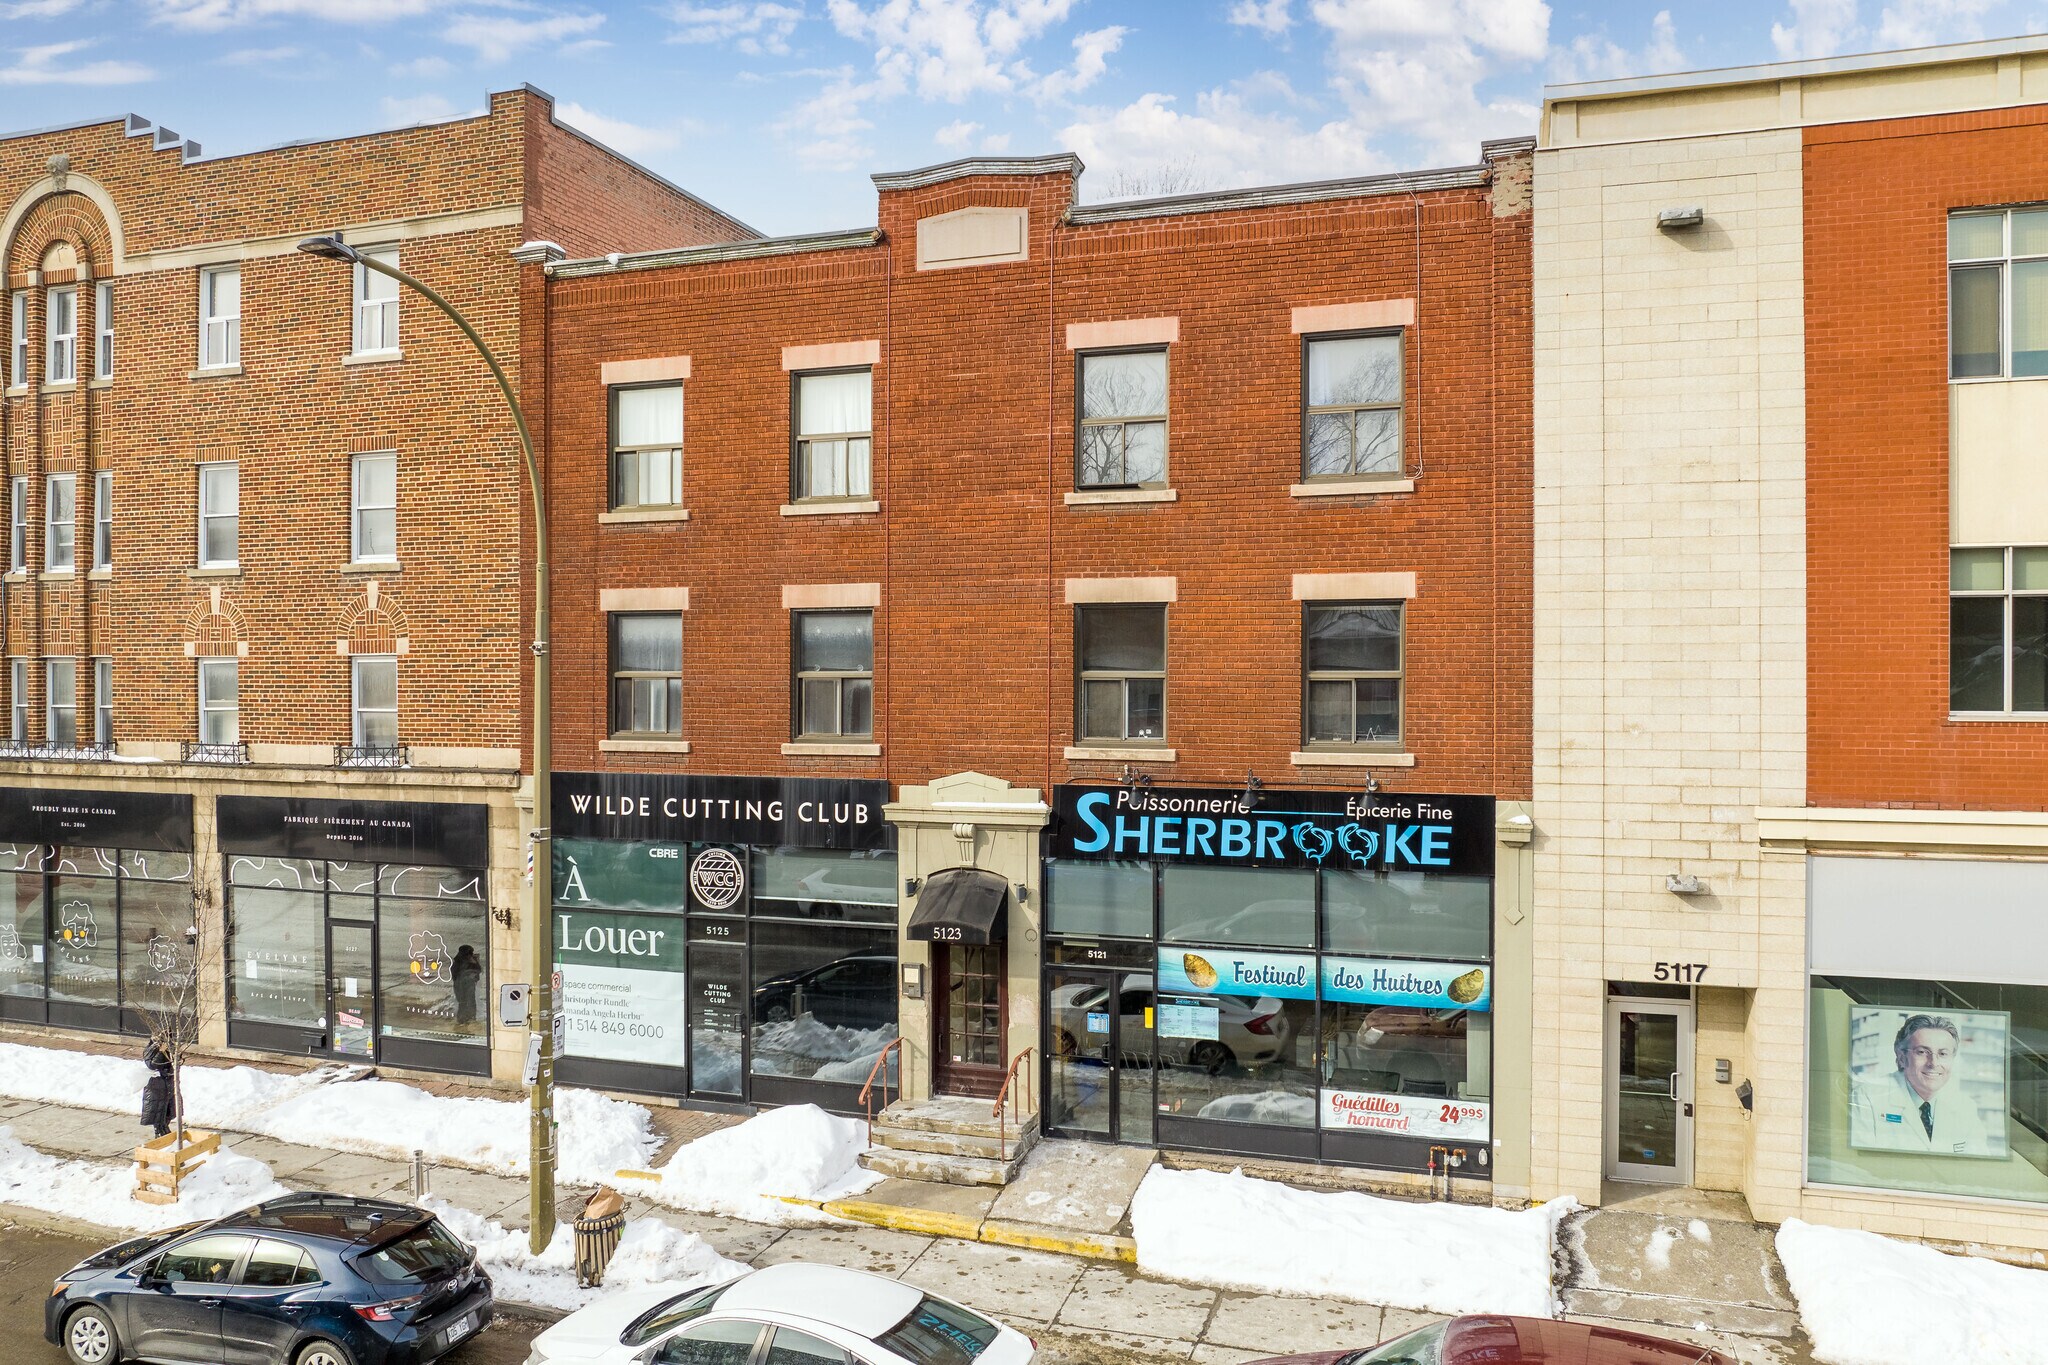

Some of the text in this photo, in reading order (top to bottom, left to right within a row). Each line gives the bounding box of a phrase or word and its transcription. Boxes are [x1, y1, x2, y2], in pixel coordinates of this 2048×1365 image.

[570, 794, 868, 824] WILDE CUTTING CLUB
[1346, 797, 1453, 820] Épicerie Fine
[284, 816, 319, 824] FABRIQUÉ
[323, 816, 365, 826] FIÈREMENT
[382, 820, 411, 828] CANADA
[326, 833, 347, 841] Depuis
[649, 848, 678, 858] CBRE
[559, 855, 591, 901] À
[699, 871, 735, 887] WCC
[558, 914, 665, 957] Louer
[706, 926, 729, 935] 5125
[933, 927, 962, 940] 5123
[247, 951, 308, 964] EVELYNE
[1087, 950, 1107, 959] 5121
[1233, 960, 1443, 995] Festival des Huîtres
[1653, 962, 1708, 983] 5117
[564, 981, 632, 993] space commercial
[708, 983, 728, 991] WILDE
[564, 995, 602, 1006] hristopher
[704, 990, 732, 998] CUTTING
[563, 1007, 590, 1016] manda
[592, 1010, 616, 1019] Angela
[576, 1018, 598, 1033] 514
[601, 1021, 626, 1036] 849
[629, 1023, 664, 1039] 6000
[1332, 1093, 1400, 1114] Guédilles
[1346, 1111, 1409, 1131] homard
